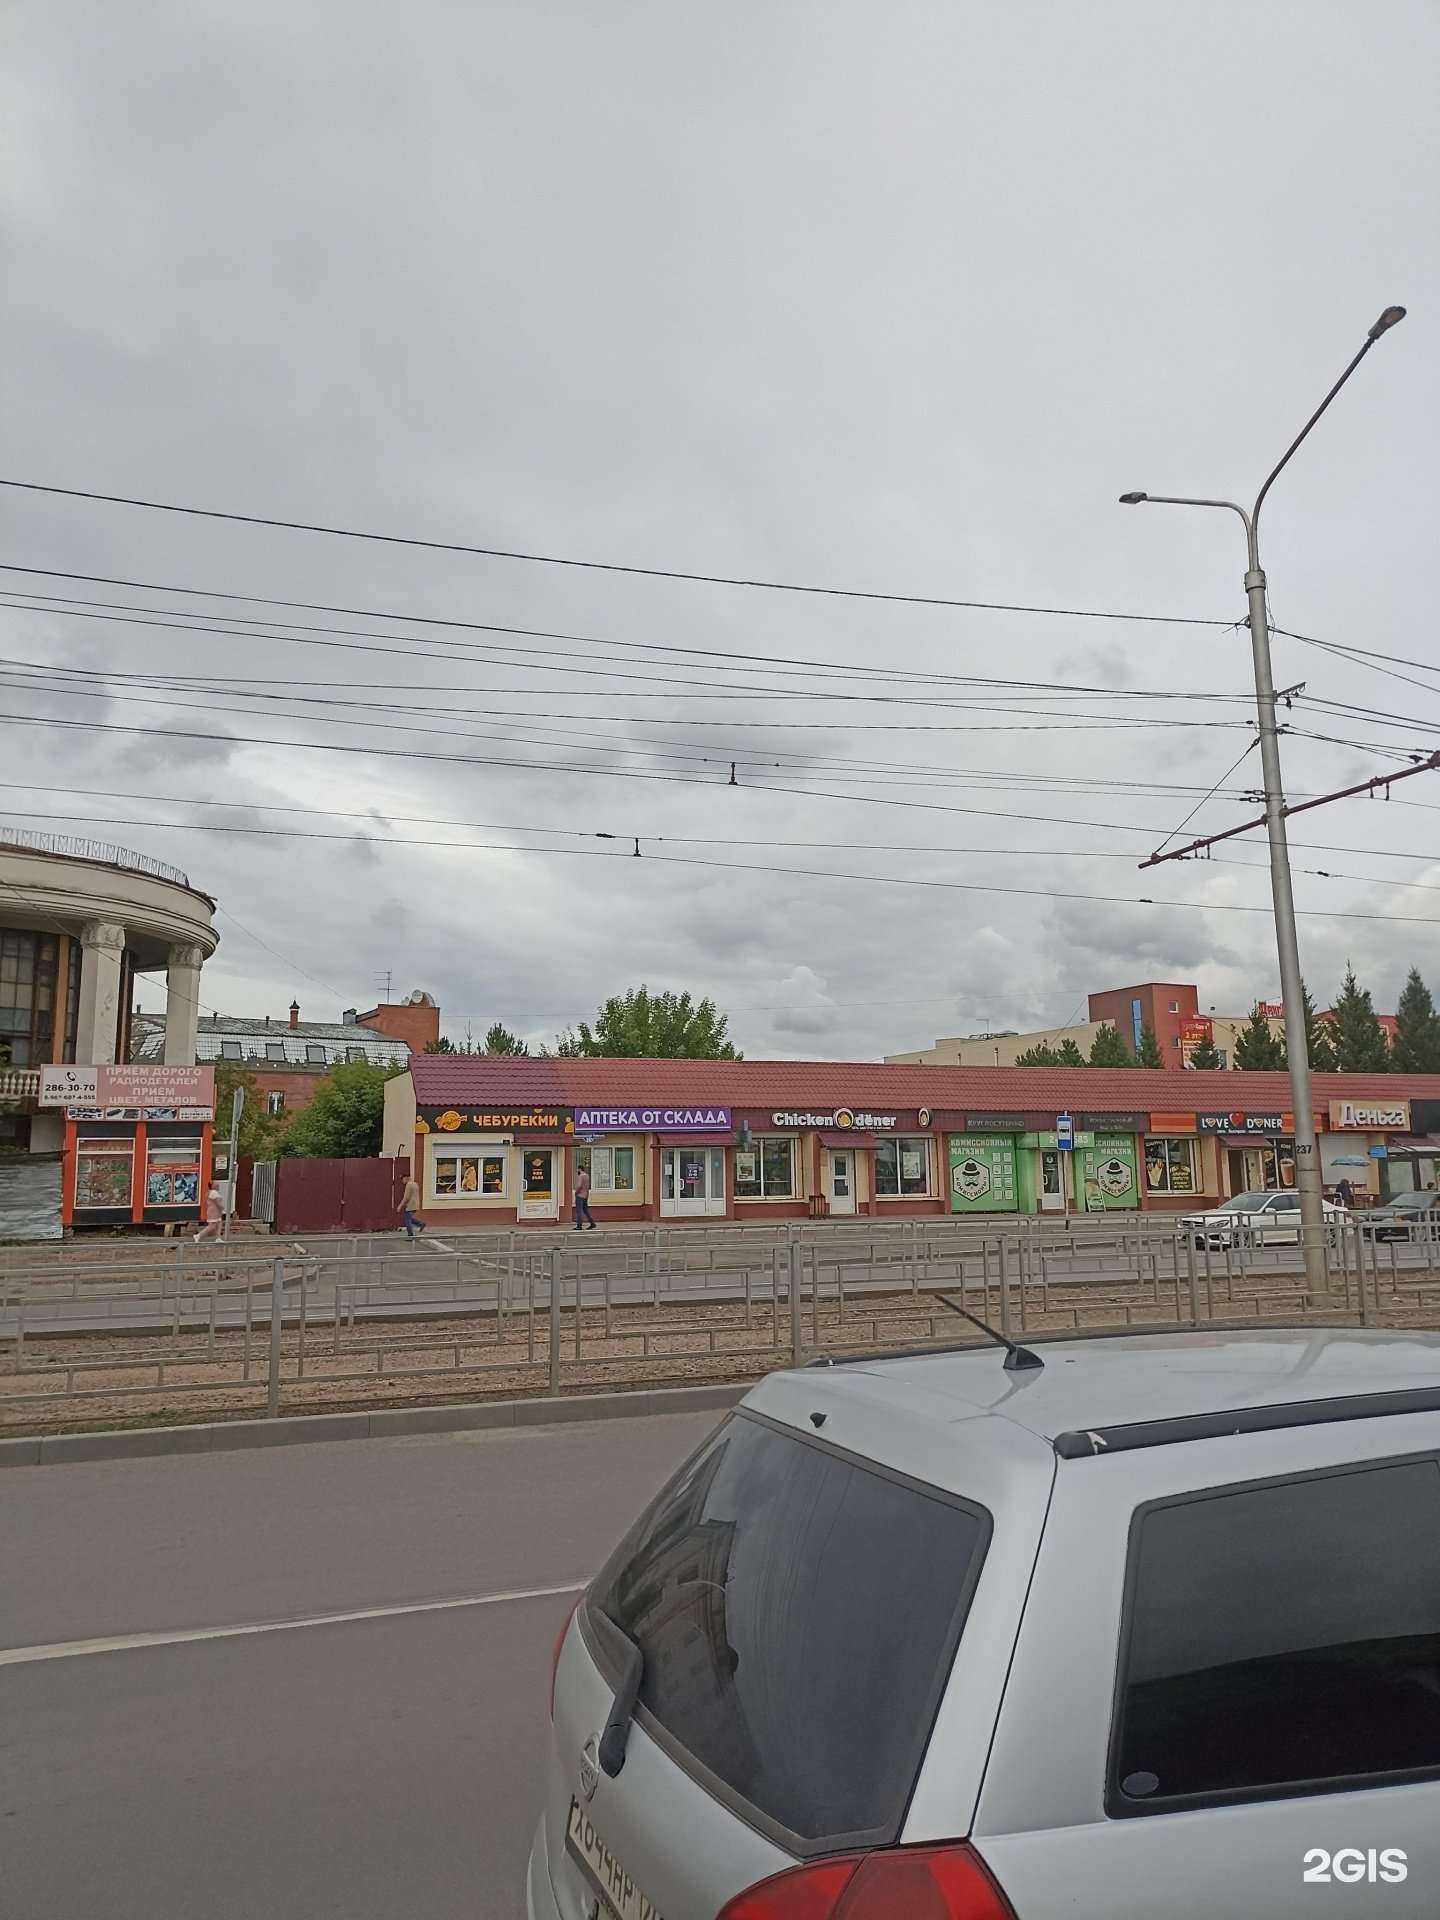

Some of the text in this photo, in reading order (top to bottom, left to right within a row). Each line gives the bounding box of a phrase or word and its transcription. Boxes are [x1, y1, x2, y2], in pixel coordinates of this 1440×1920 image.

[152, 1067, 202, 1076] ДОРОГО
[46, 1084, 95, 1092] 286-30-70
[579, 1110, 727, 1125] АПТЕКА ОТ СКЛАДА
[771, 1112, 834, 1126] Chicken
[1338, 1103, 1405, 1127] Деньга
[473, 1115, 558, 1127] ЧЕБУРЕКМИ
[1201, 1118, 1229, 1128] LOVE
[951, 1147, 985, 1155] МАГАЗИН
